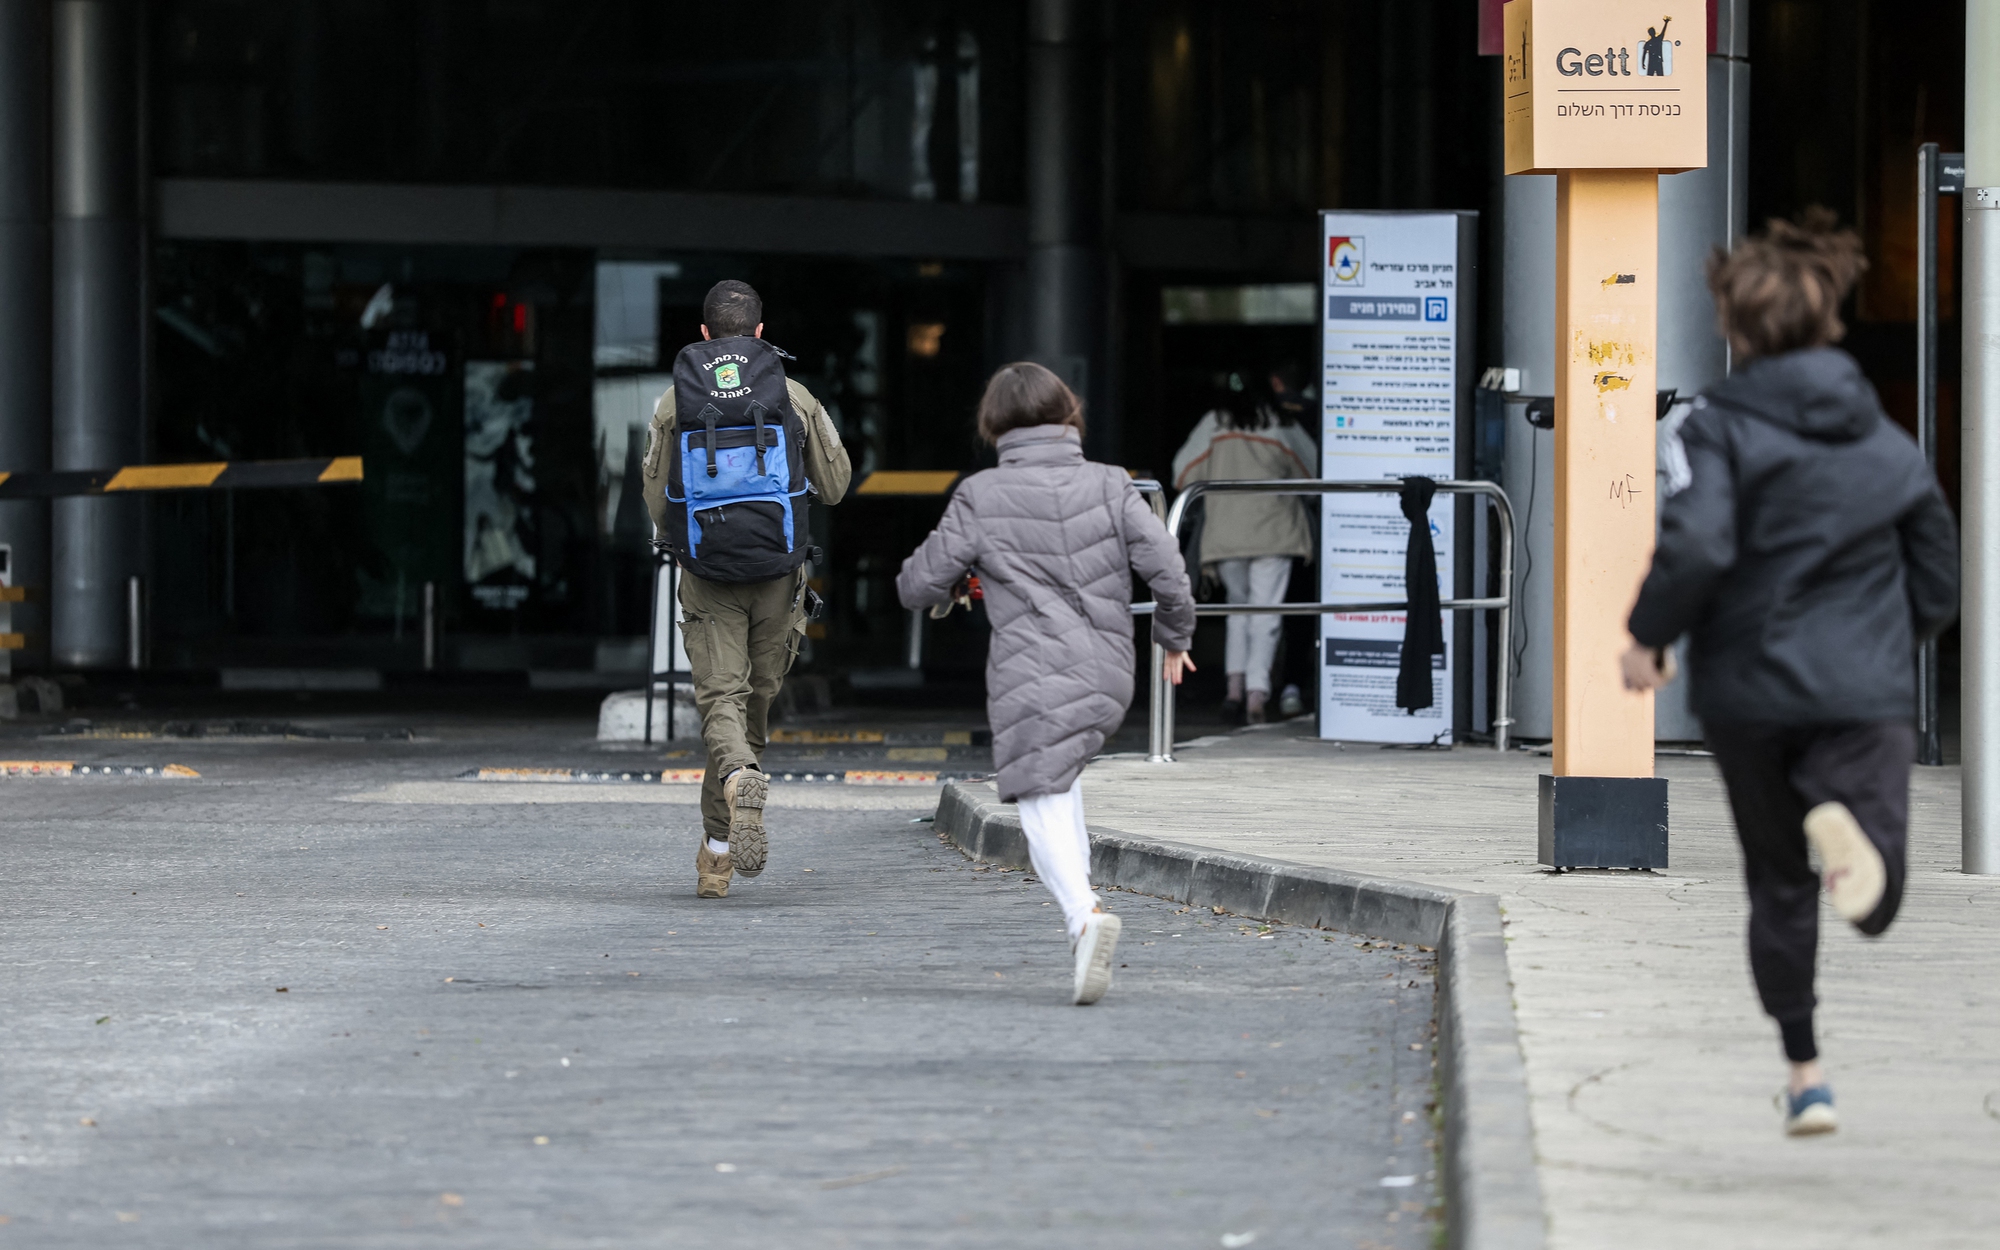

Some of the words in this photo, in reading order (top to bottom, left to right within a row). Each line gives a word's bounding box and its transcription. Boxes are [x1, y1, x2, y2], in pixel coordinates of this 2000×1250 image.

[1556, 47, 1631, 76] Gett
[1557, 102, 1605, 116] השלום
[1610, 104, 1634, 119] דרך
[1638, 104, 1681, 116] כניסת
[1370, 262, 1404, 272] עזריאלי
[1407, 263, 1429, 272] מרכז
[1432, 264, 1453, 274] חניון
[1414, 280, 1436, 288] אביב
[1440, 279, 1453, 288] תל
[1350, 302, 1374, 313] חניה
[1376, 303, 1416, 317] מחירון
[711, 386, 752, 398] באהבה
